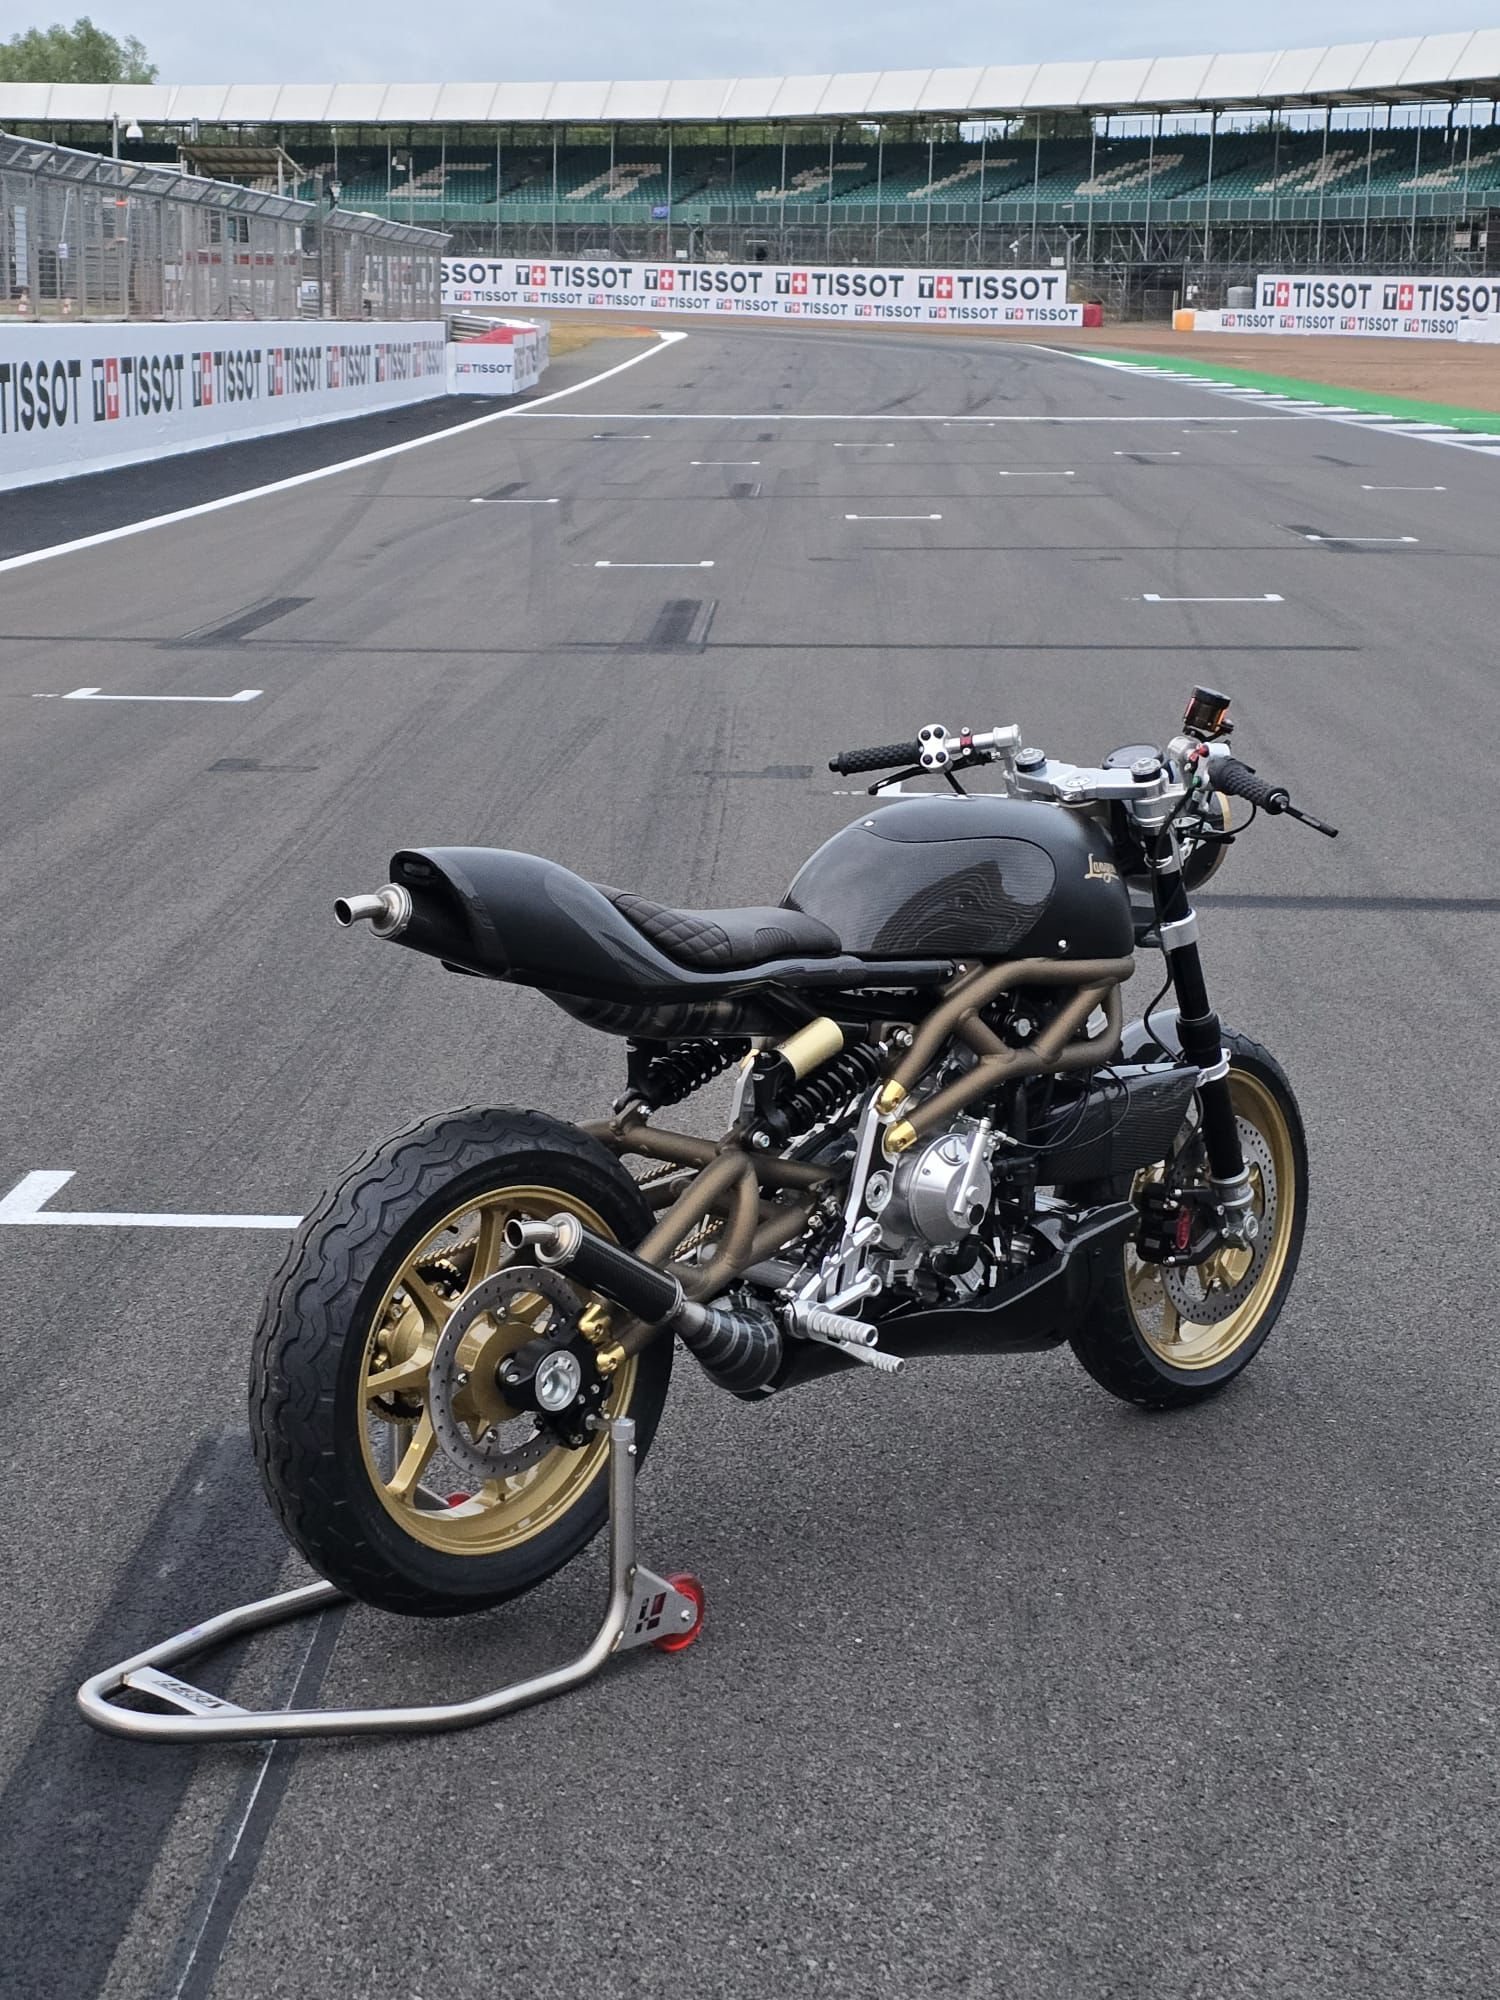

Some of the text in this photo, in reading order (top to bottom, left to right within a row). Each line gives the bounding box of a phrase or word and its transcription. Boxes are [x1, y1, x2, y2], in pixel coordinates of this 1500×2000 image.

[550, 264, 632, 289] TISSOT
[678, 269, 763, 294] TISSOT
[812, 272, 904, 298] TISSOT
[957, 275, 1058, 301] TISSOT
[1293, 282, 1372, 310] TISSOT
[1418, 284, 1500, 313] TISSOT
[473, 290, 518, 302] TISSOT
[540, 292, 583, 304] TISSOT
[607, 294, 646, 307] TISSOT
[669, 296, 711, 309] TISSOT
[734, 299, 779, 312] TISSOT
[802, 301, 848, 316] TISSOT
[874, 304, 921, 318] TISSOT
[950, 306, 998, 320] TISSOT
[1027, 308, 1078, 321] TISSOT
[1236, 314, 1275, 328] TISSOT
[1296, 315, 1335, 329] TISSOT
[1358, 316, 1399, 332] TISSOT
[471, 363, 512, 374] TISSOT
[0, 359, 81, 434] TISSOT
[120, 353, 183, 416] TISSOT
[214, 349, 262, 404] TISSOT
[284, 346, 322, 394] TISSOT
